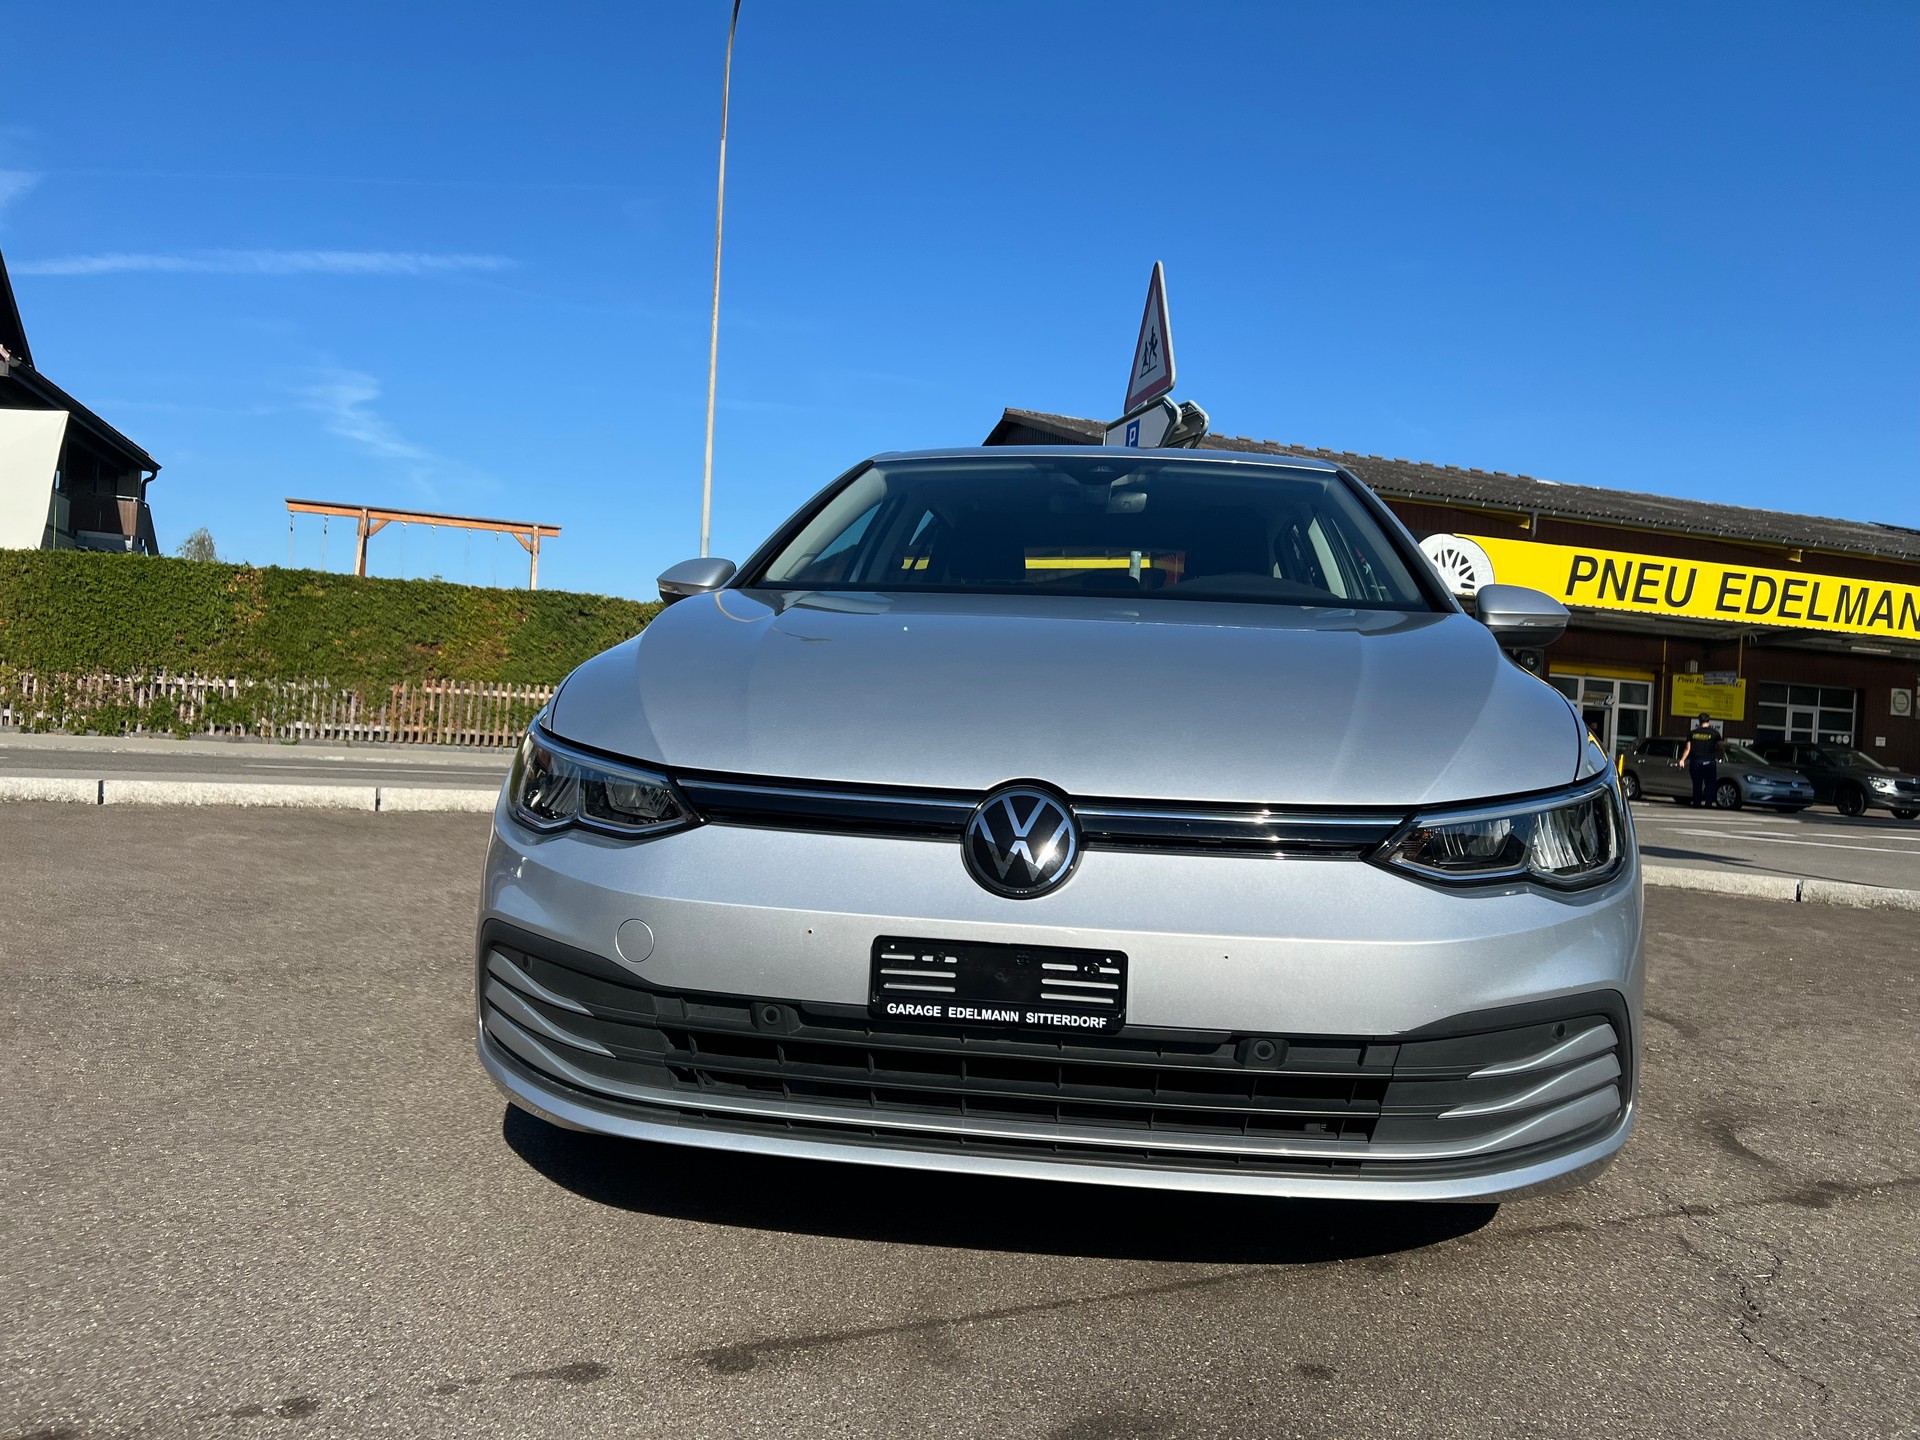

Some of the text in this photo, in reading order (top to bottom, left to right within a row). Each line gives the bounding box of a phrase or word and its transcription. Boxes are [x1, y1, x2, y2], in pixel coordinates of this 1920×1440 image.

[1129, 426, 1136, 447] P
[1565, 555, 1920, 632] PNEU EDELMAN
[976, 794, 1070, 882] VW
[887, 1003, 1107, 1028] GARAGE EDELMANN SITTERDORF
